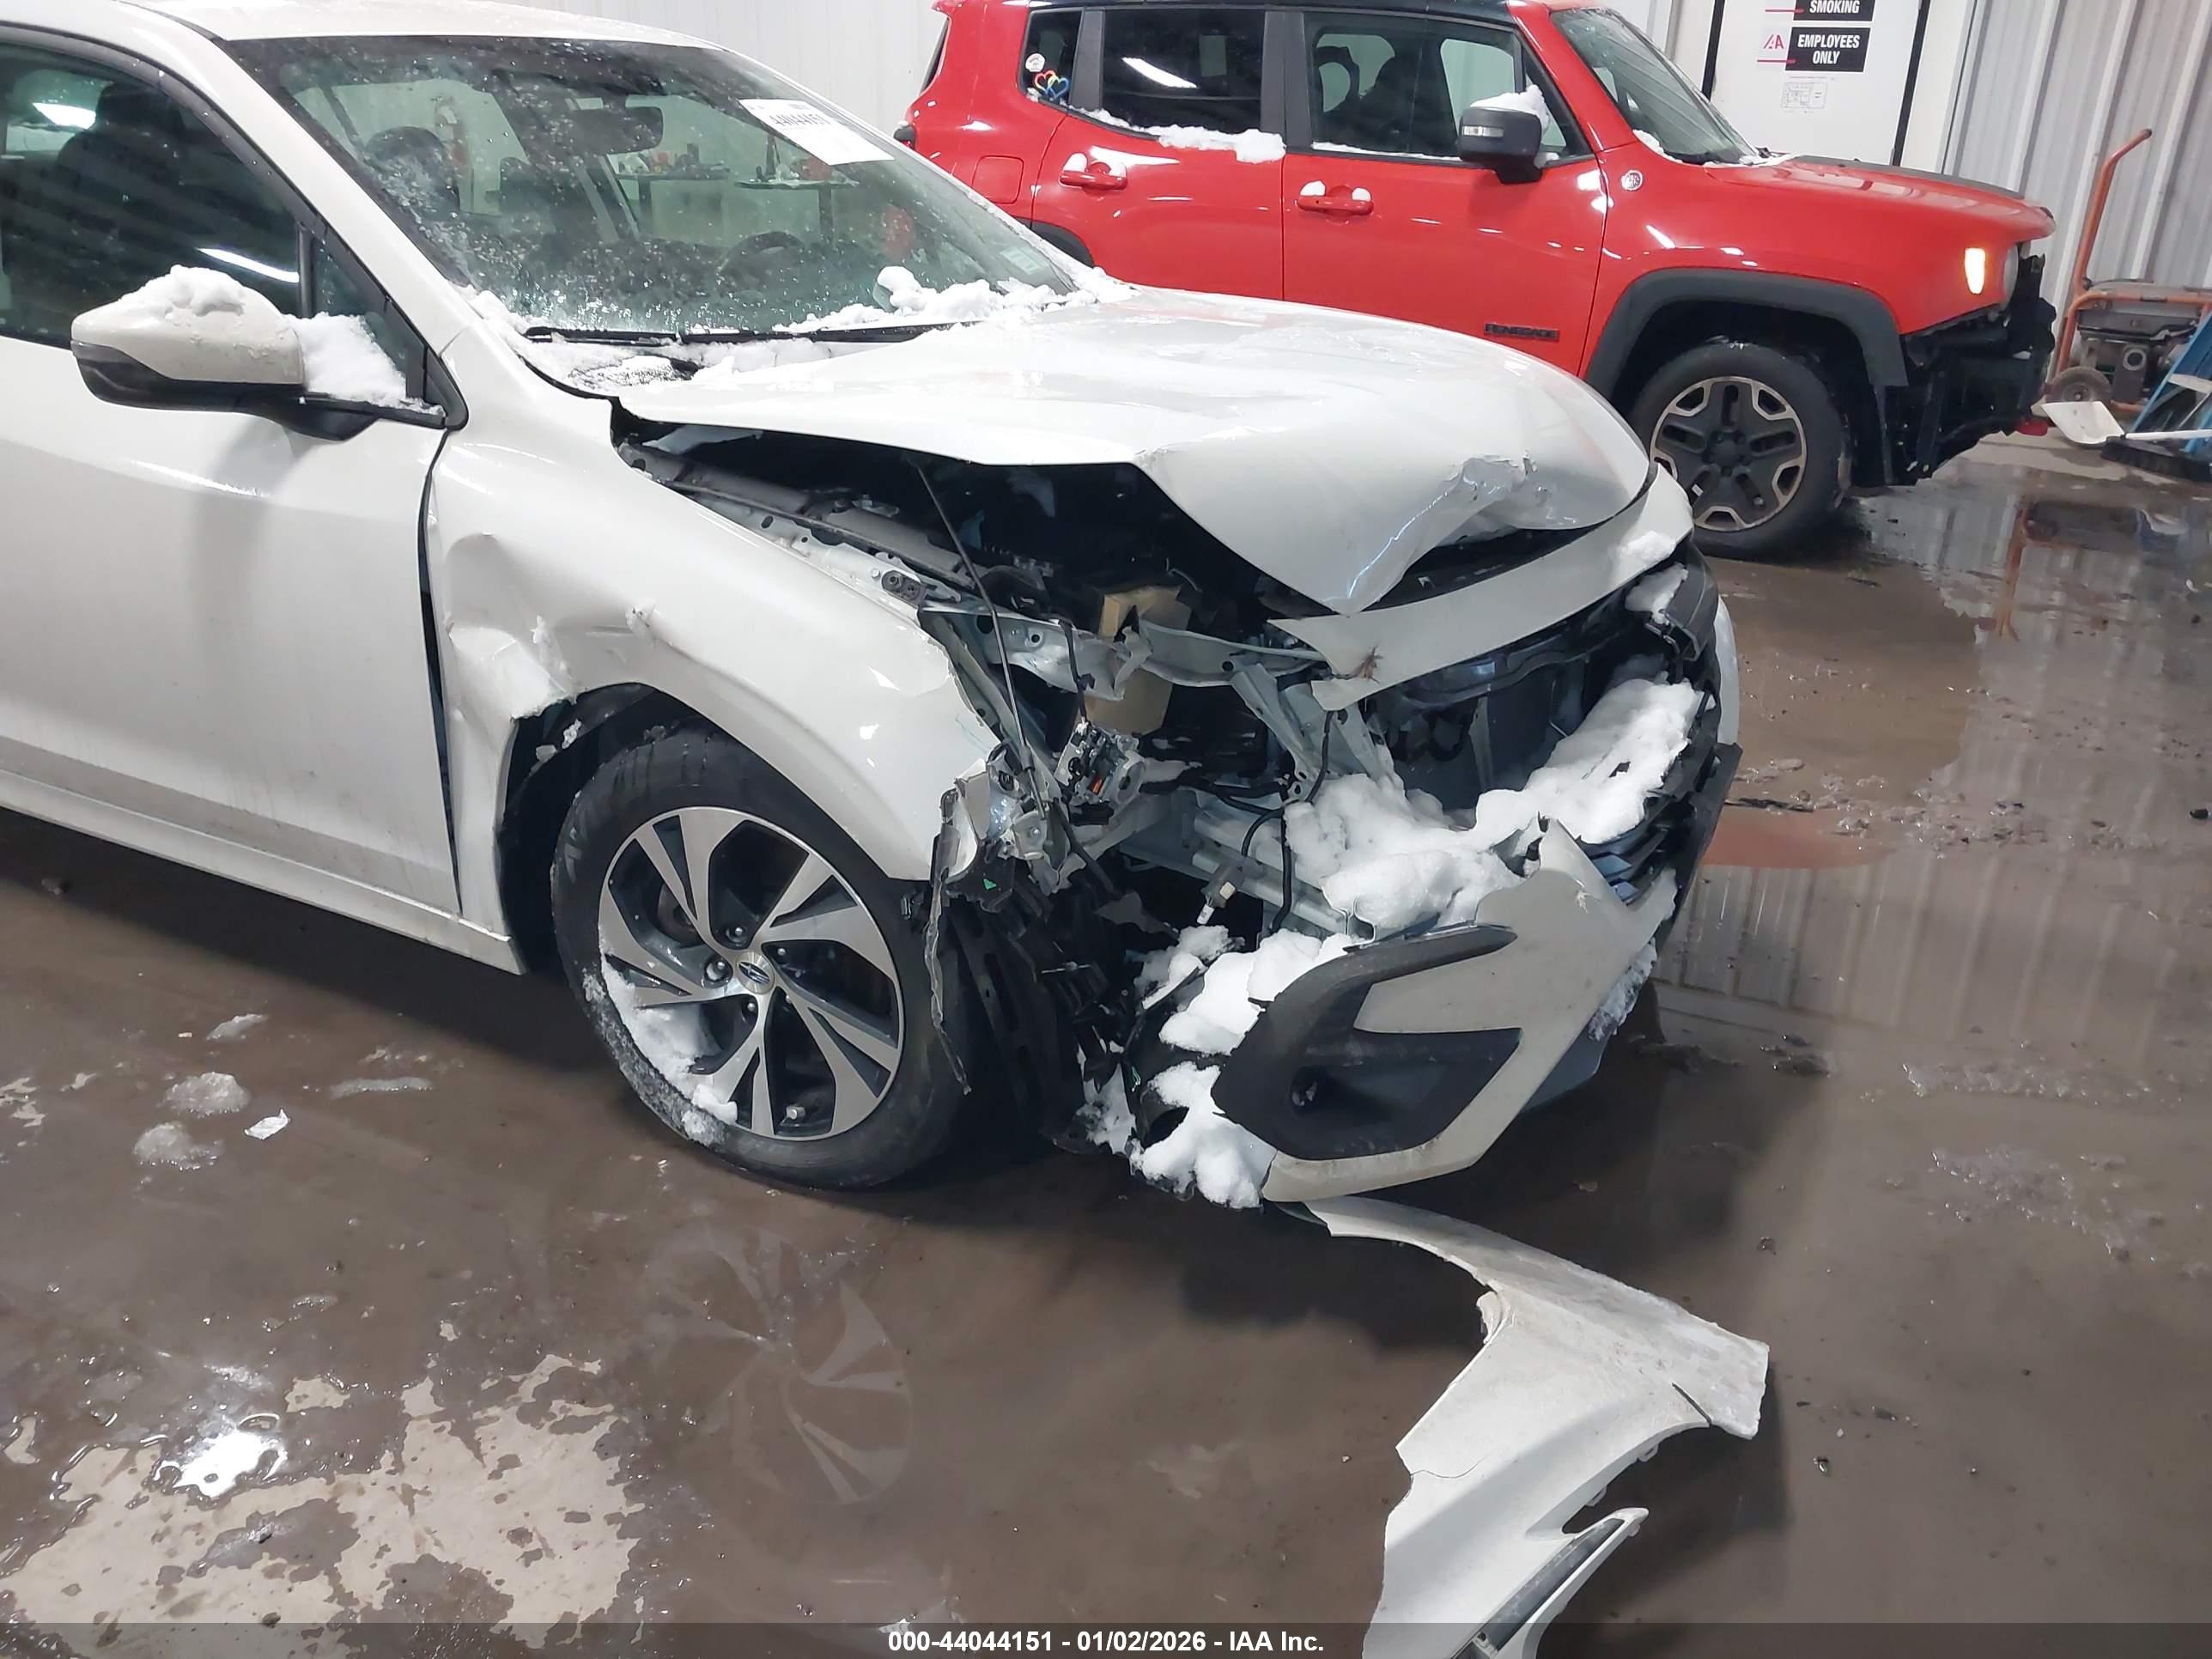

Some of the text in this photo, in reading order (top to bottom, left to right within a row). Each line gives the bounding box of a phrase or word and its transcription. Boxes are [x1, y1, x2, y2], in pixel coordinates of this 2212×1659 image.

[1809, 0, 1861, 14] SMOKING
[1797, 33, 1861, 49] EMPLOYEES
[1812, 51, 1841, 64] ONLY
